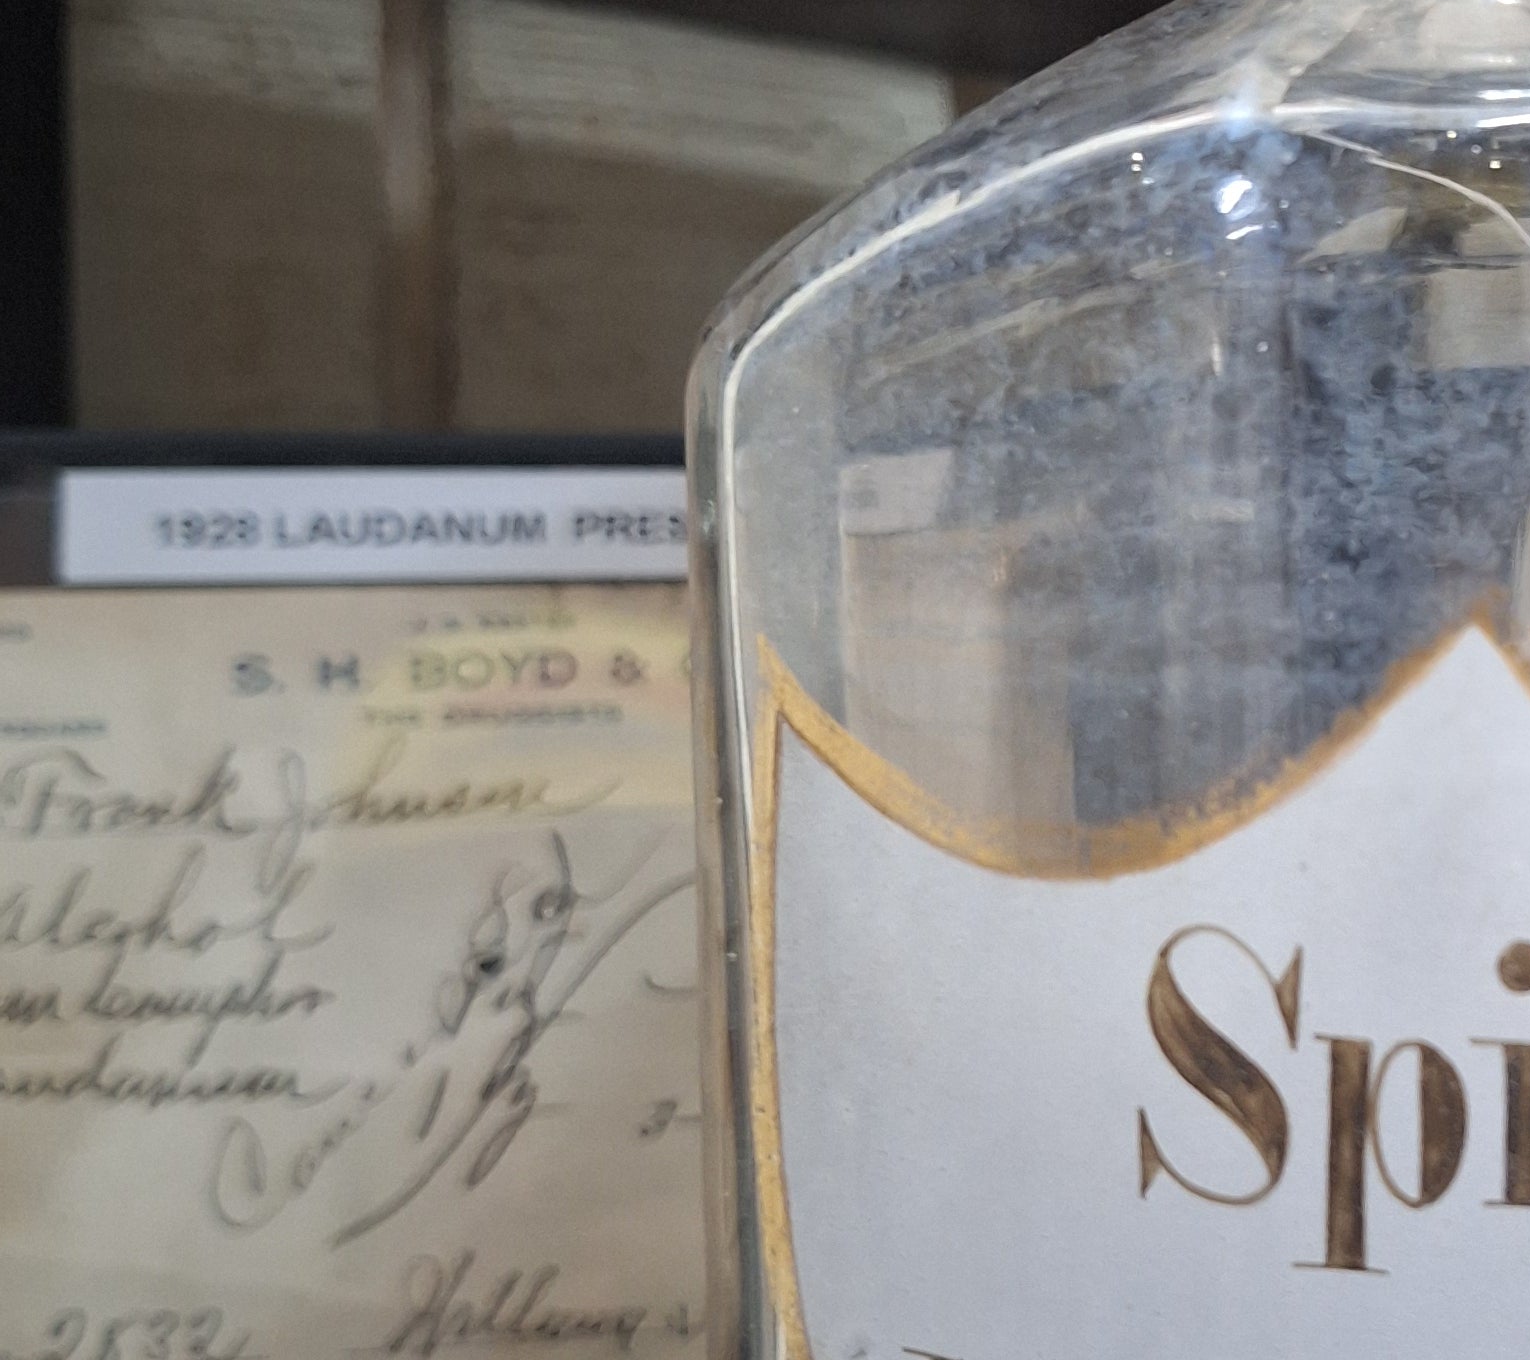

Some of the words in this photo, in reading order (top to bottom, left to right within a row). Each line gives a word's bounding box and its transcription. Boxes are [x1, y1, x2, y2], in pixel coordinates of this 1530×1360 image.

[272, 506, 548, 548] LAUDANUM
[571, 506, 690, 546] PRES
[407, 648, 578, 692] BOYD
